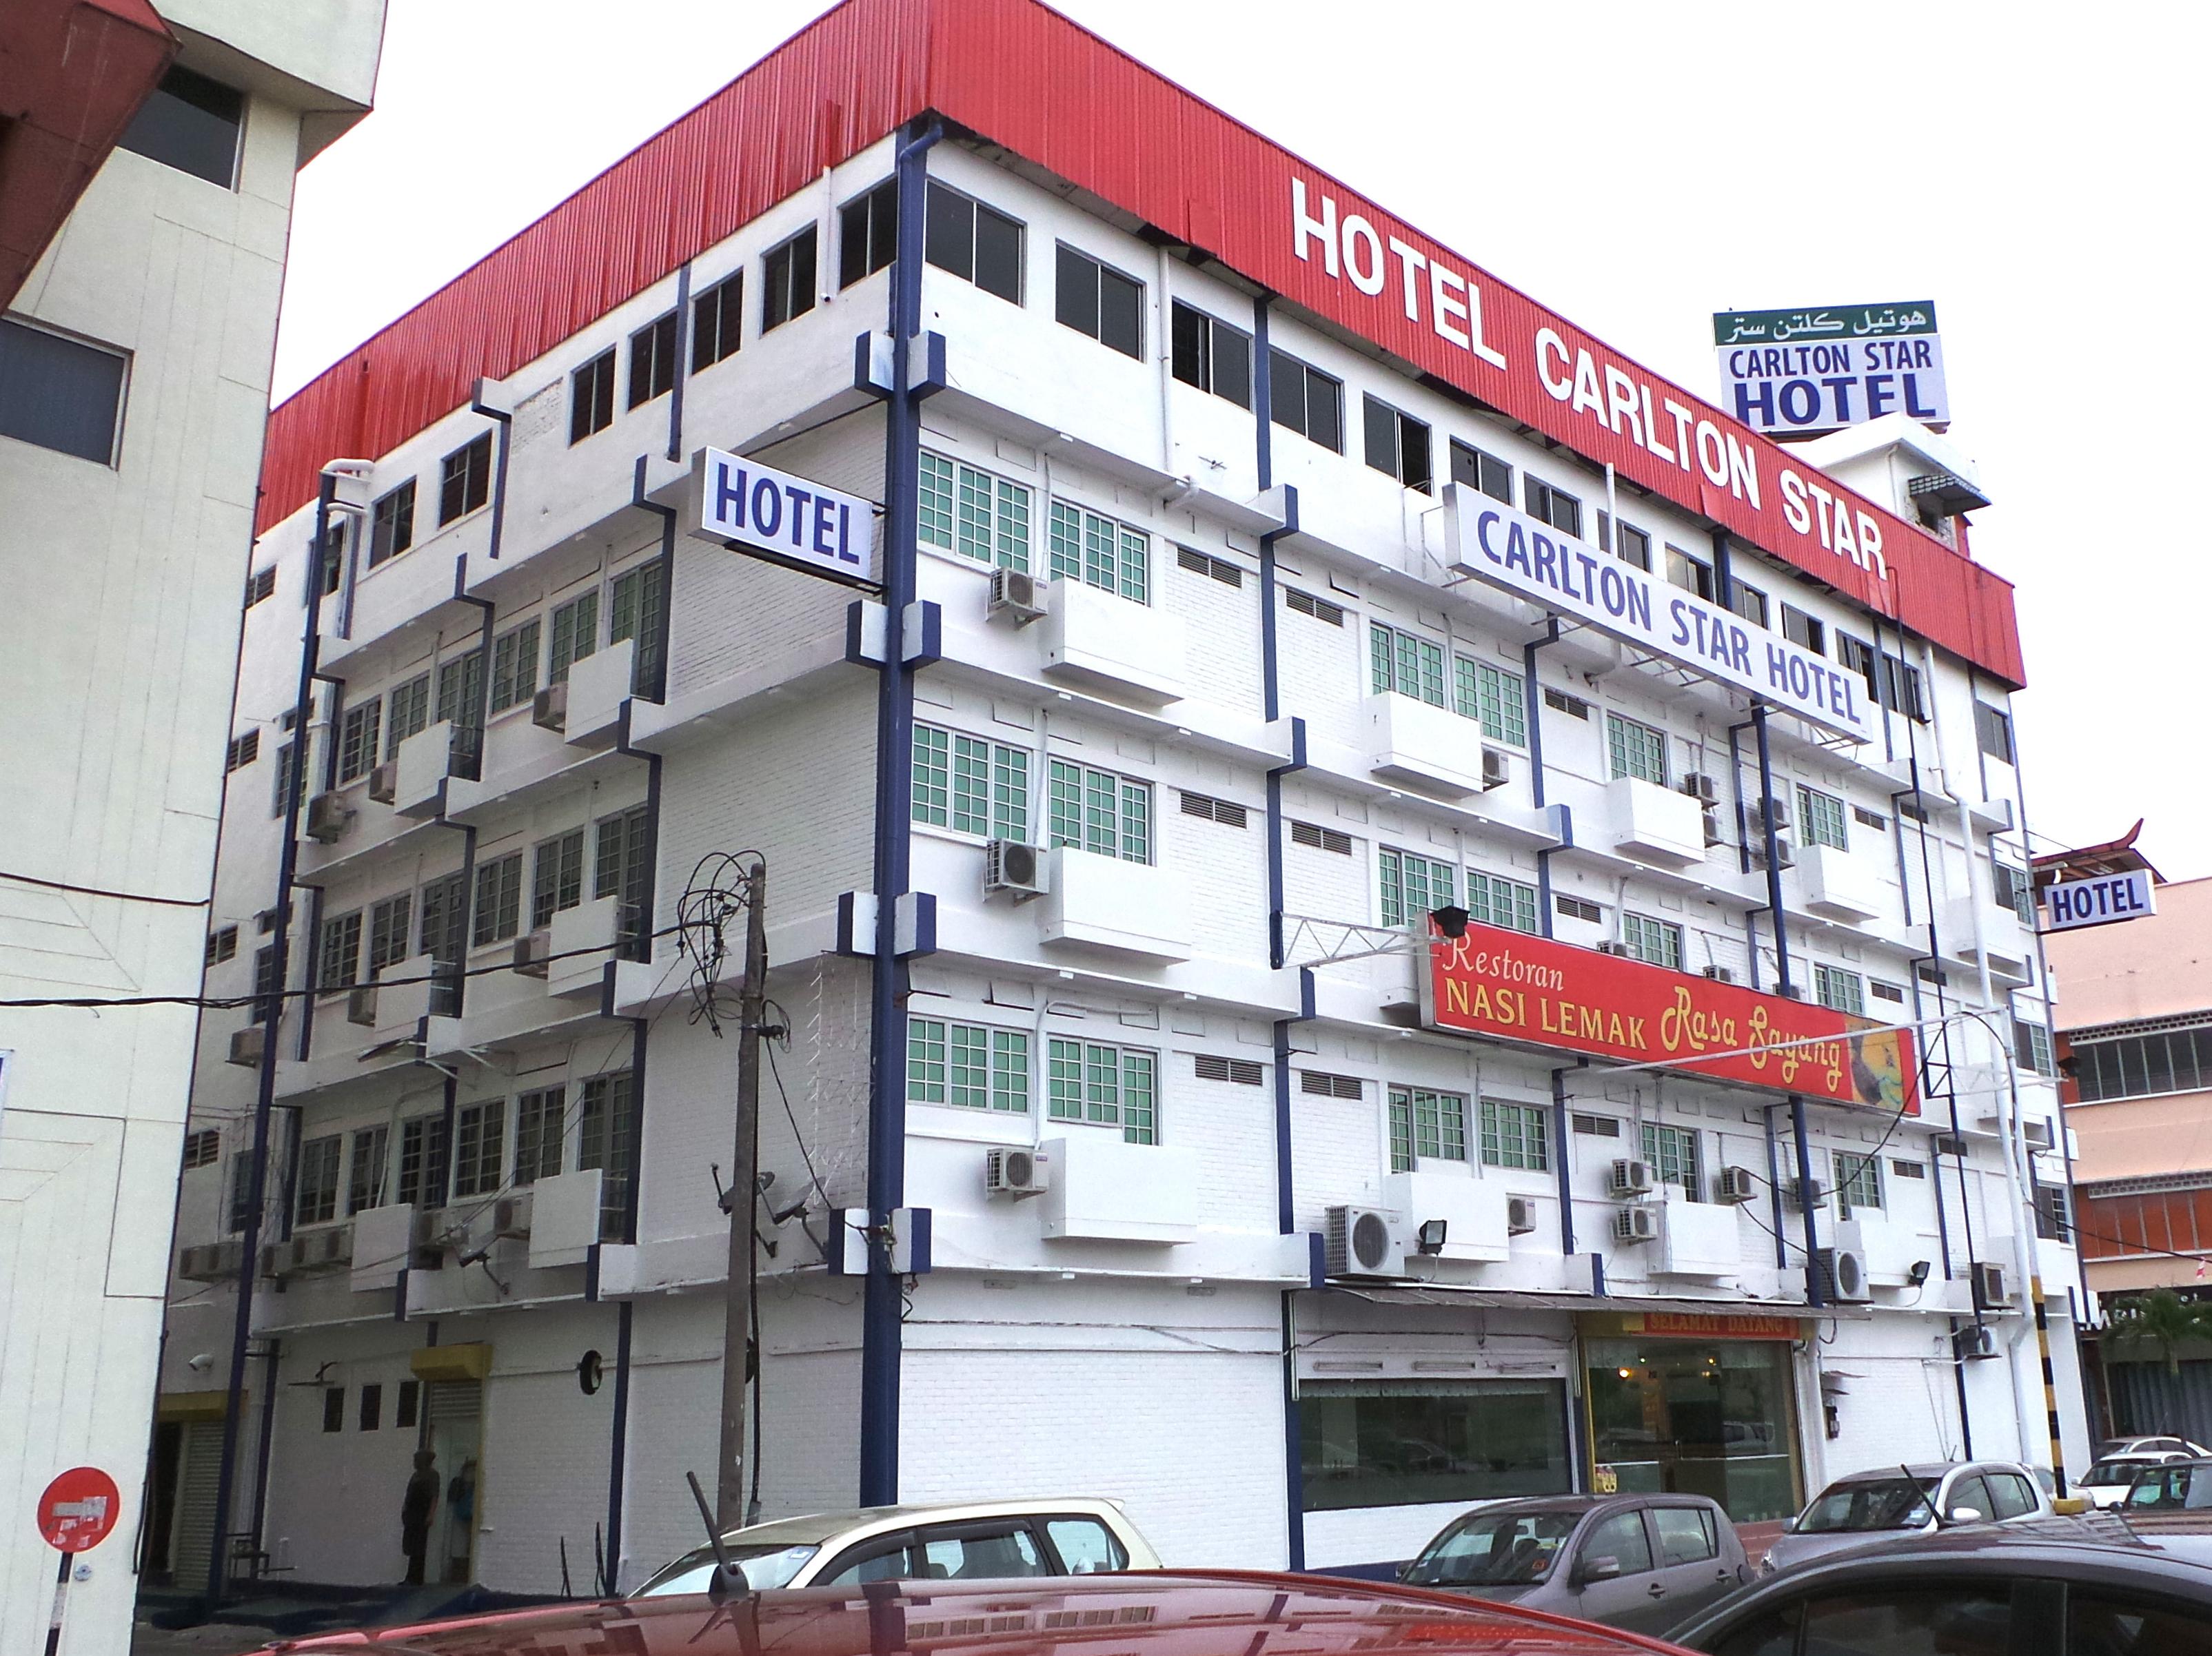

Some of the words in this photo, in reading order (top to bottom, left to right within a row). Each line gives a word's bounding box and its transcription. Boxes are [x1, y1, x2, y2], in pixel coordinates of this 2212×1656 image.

[1774, 312, 1845, 340] كلتن
[1853, 309, 1927, 335] هوتيل
[1292, 176, 1506, 370] HOTEL
[1535, 327, 1761, 510] CARLTON
[1782, 470, 1888, 579] STAR
[1729, 345, 1851, 378] CARLTON
[1865, 339, 1932, 371] STAR
[1734, 373, 1936, 427] HOTEL
[716, 462, 860, 565] HOTEL
[1477, 511, 1652, 631] CARLTON
[1671, 599, 1753, 677] STAR
[1766, 642, 1860, 724] HOTEL
[2052, 878, 2143, 923] HOTEL
[1442, 930, 1564, 992] Restoran
[1445, 977, 1526, 1027] NASI
[1540, 997, 1648, 1051] LEMAK
[1661, 985, 1738, 1052] Rasa
[1748, 1005, 1843, 1093] Sayang
[1650, 1313, 1719, 1331] SELAMAT
[1728, 1316, 1784, 1332] DATANG
